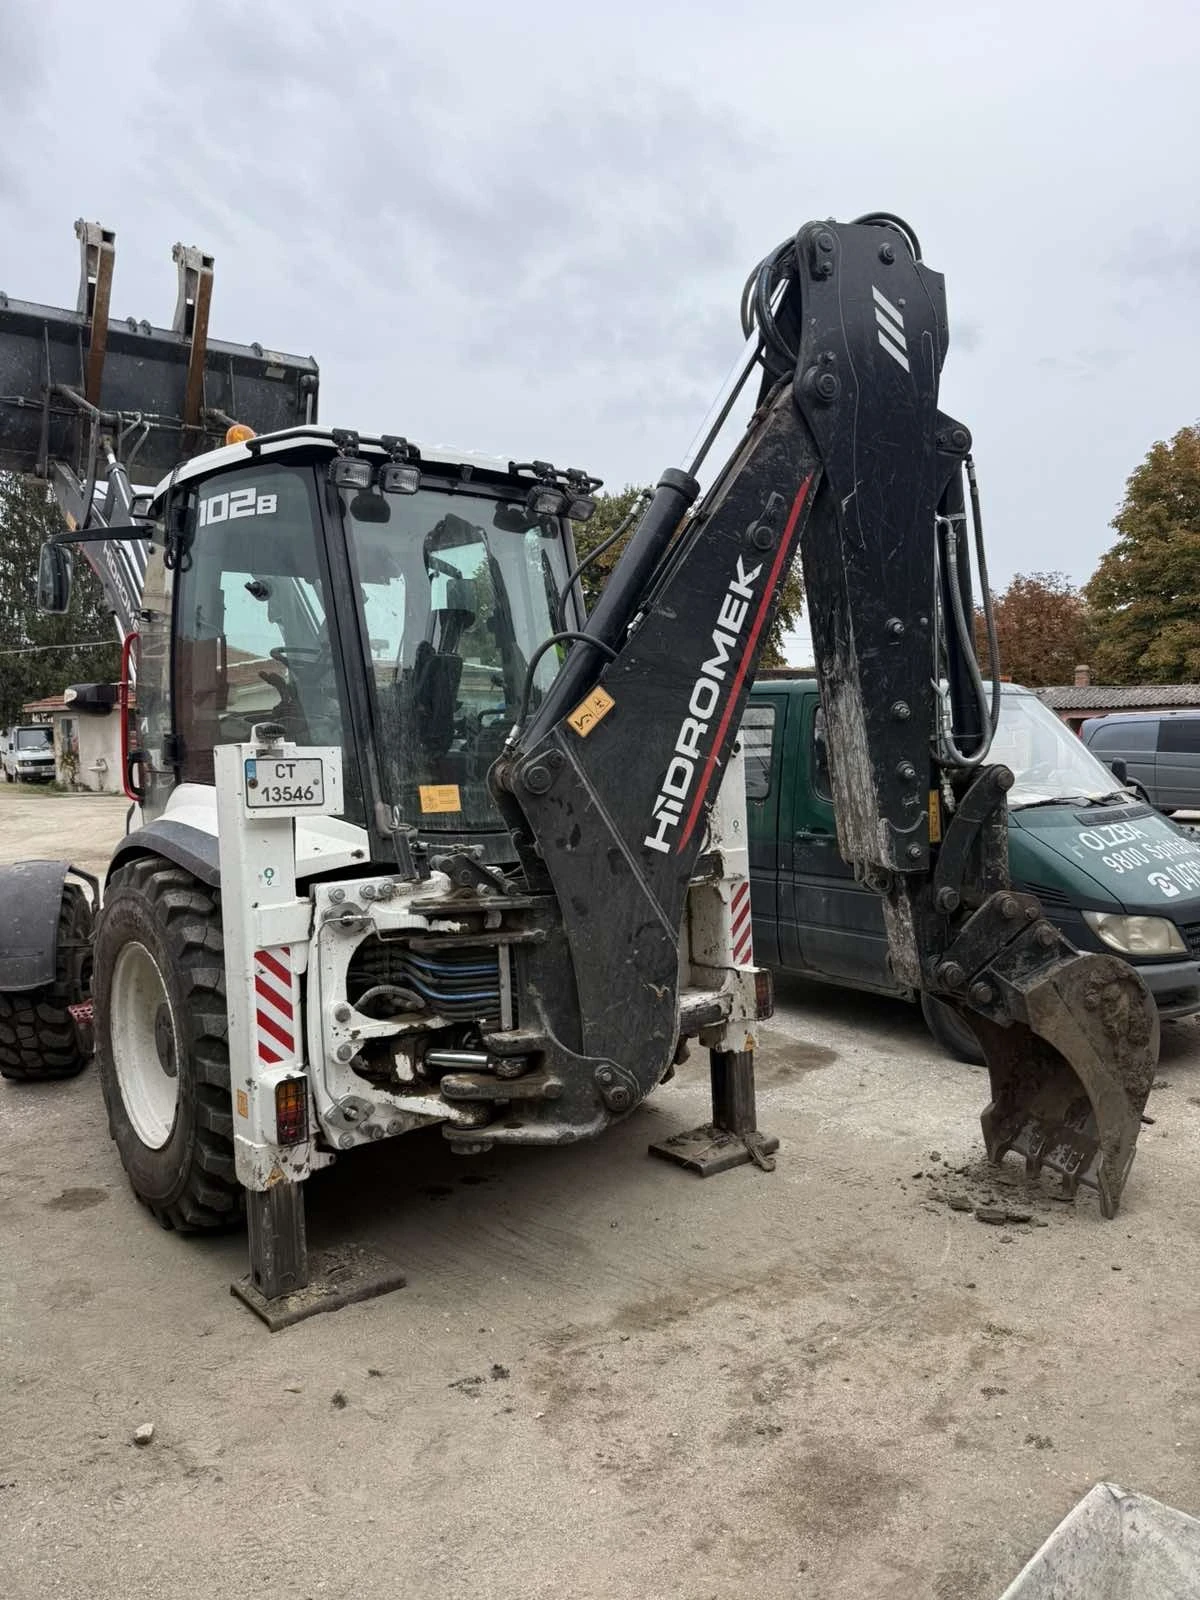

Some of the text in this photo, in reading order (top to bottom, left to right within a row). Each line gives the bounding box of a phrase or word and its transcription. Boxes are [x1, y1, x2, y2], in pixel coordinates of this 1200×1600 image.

[198, 487, 278, 528] 102B
[275, 763, 296, 779] CT
[261, 785, 314, 802] 13546
[1102, 847, 1150, 874] 9800
